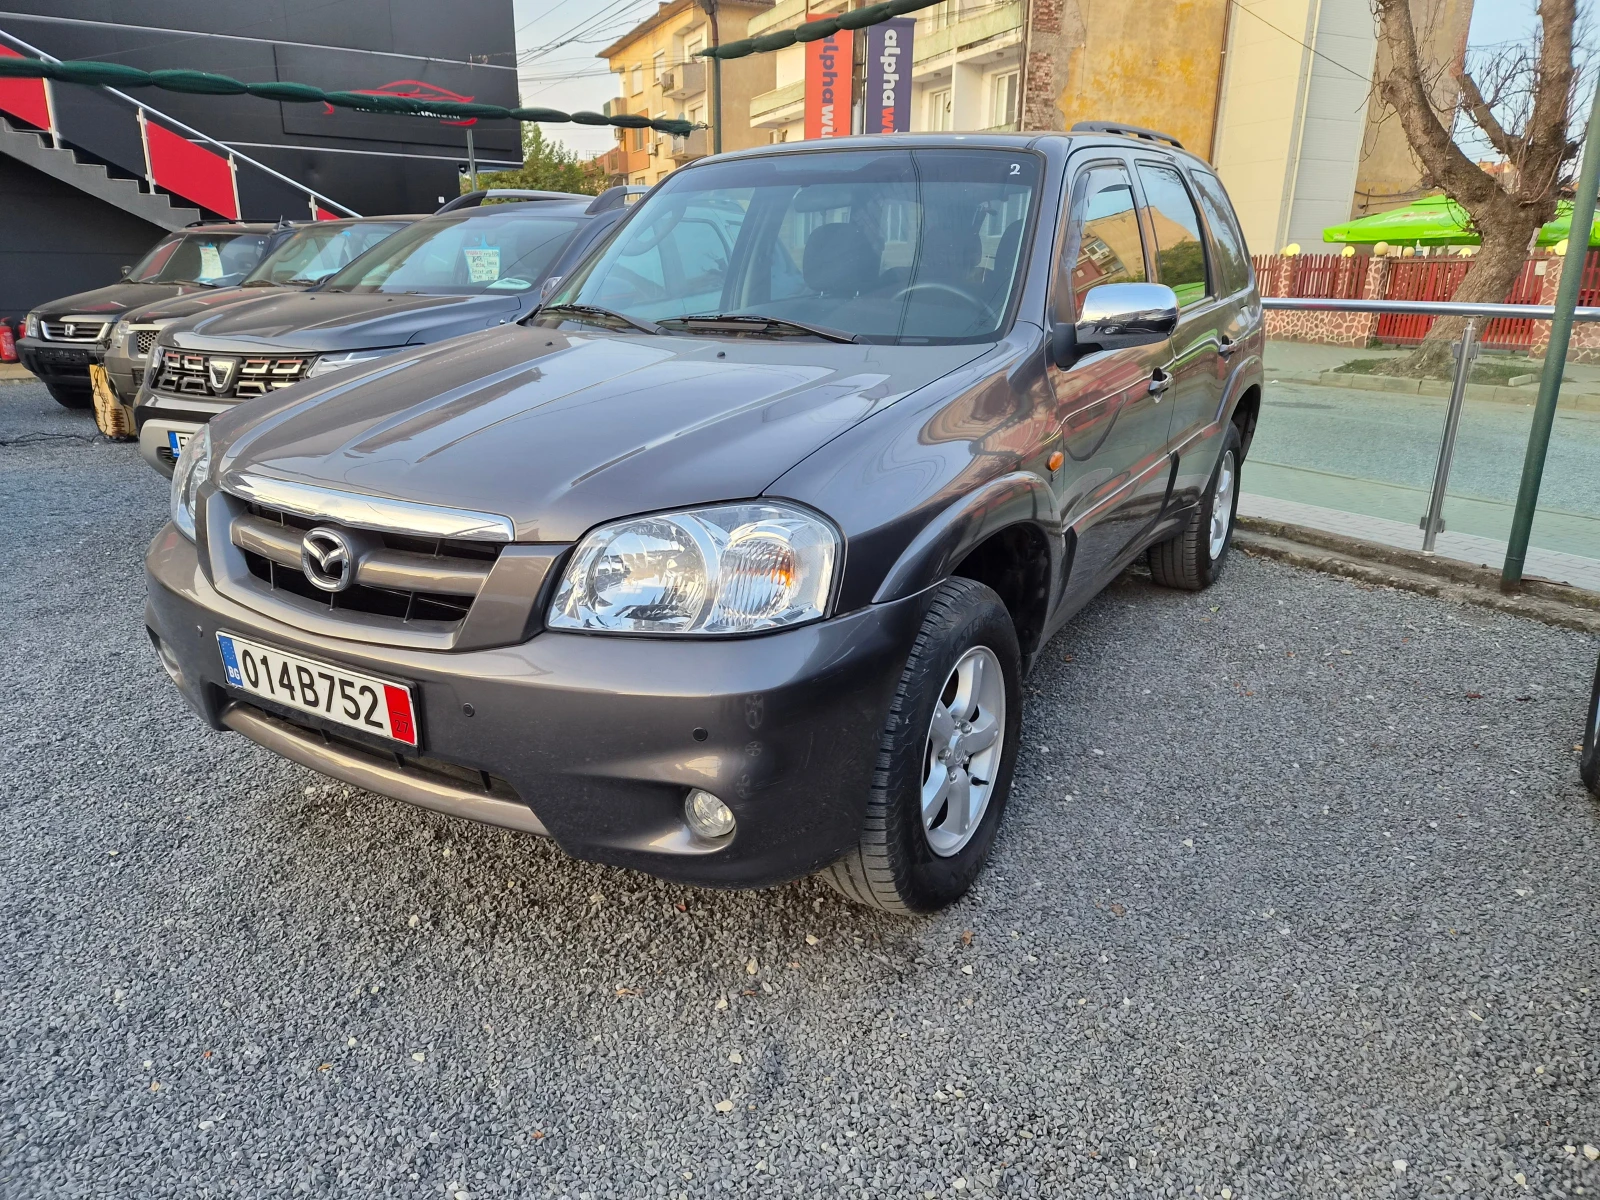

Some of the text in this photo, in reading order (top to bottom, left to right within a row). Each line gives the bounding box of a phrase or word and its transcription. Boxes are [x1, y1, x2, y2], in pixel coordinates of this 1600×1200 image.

[1009, 163, 1021, 175] 2
[227, 665, 241, 680] BG
[241, 649, 384, 729] 014B752
[394, 719, 409, 734] 27
